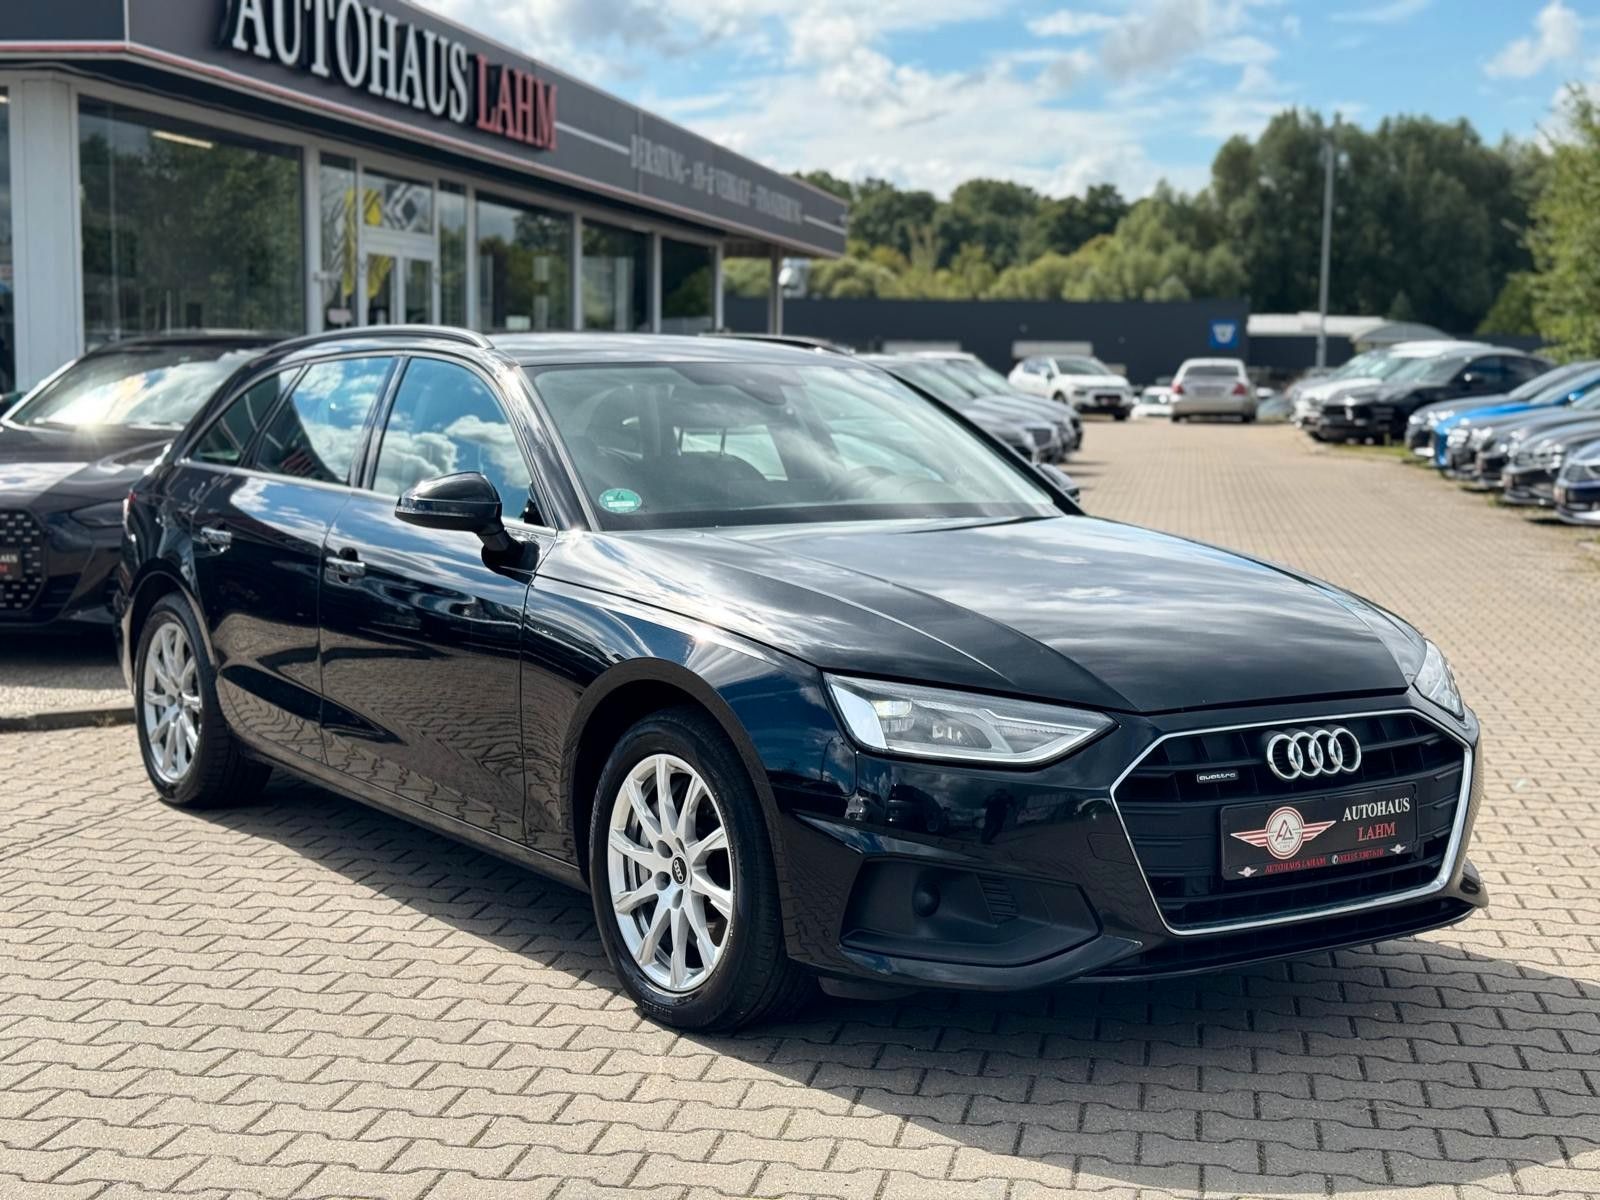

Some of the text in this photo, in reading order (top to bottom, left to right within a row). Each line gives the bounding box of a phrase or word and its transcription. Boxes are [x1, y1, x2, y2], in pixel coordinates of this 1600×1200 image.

[232, 0, 557, 151] AUTOHAUS LAHM
[1199, 772, 1236, 781] quattro
[1342, 797, 1411, 822] AUTOHAUS
[1357, 822, 1396, 842] LAHM
